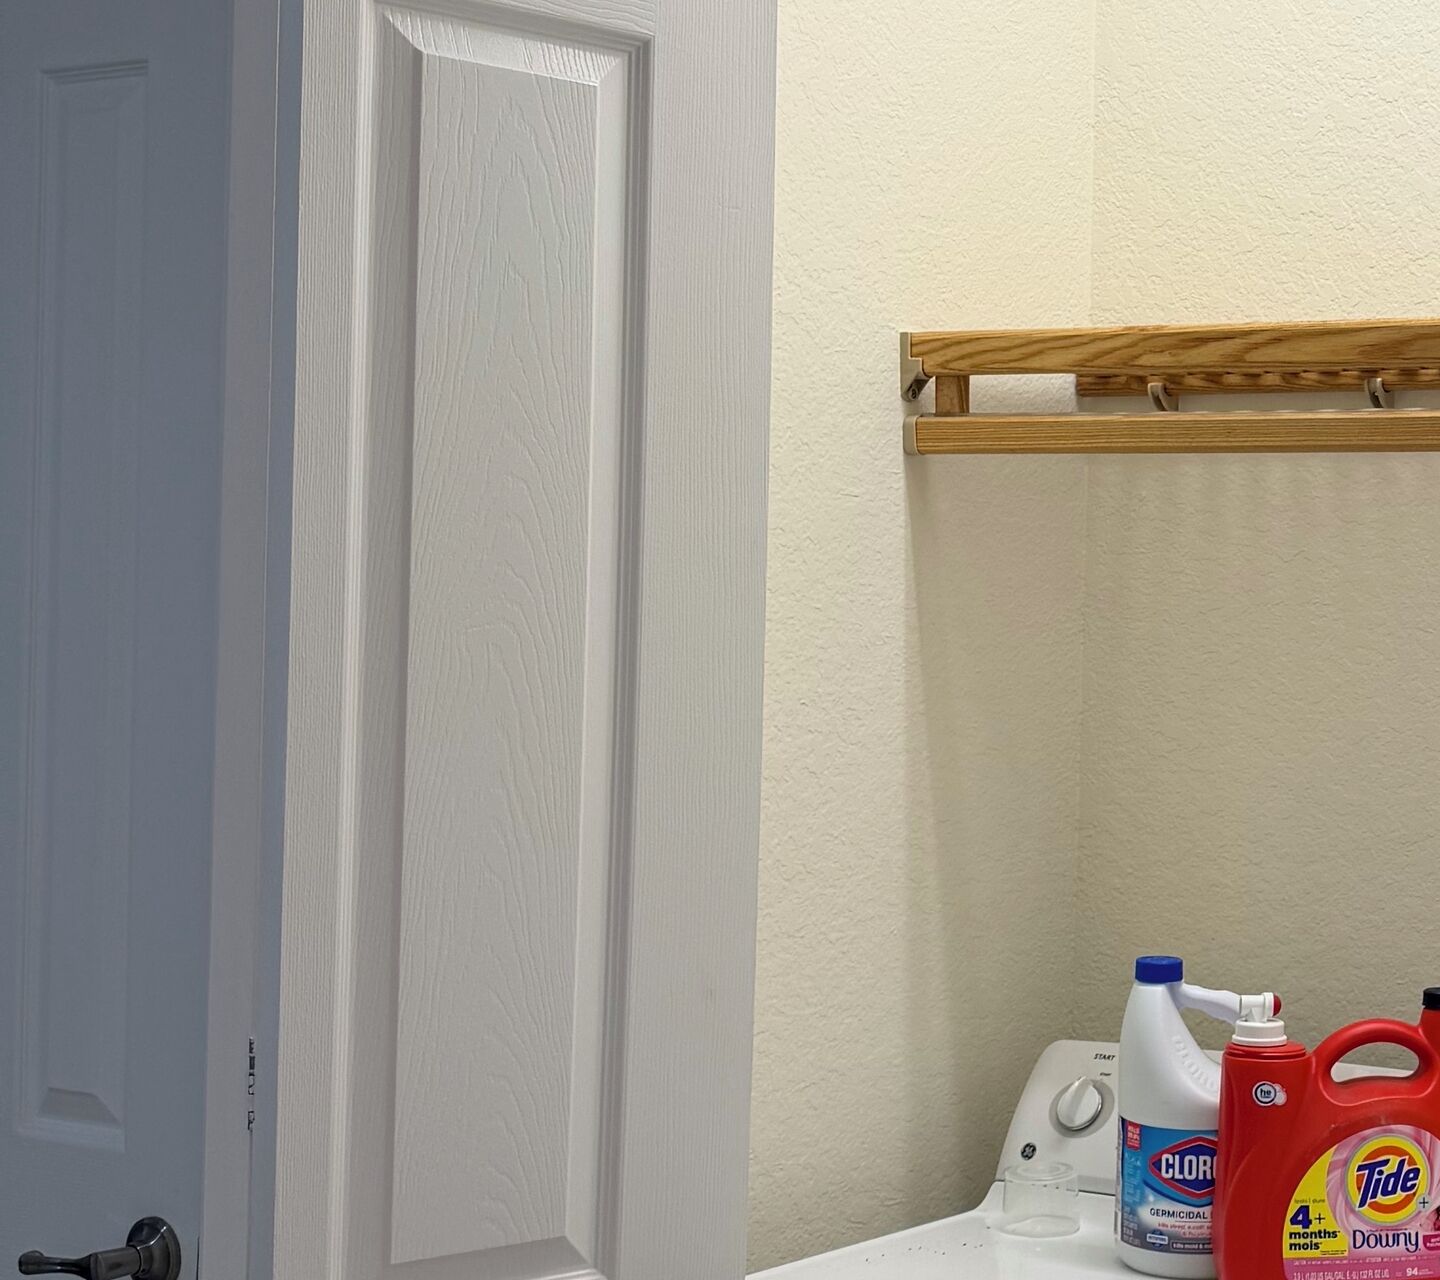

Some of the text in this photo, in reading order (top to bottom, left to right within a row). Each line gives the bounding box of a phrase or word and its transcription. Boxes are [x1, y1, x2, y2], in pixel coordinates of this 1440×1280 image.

[1094, 1053, 1116, 1061] START
[1259, 1088, 1273, 1097] he
[1356, 1157, 1421, 1208] Tide
[1149, 1207, 1208, 1220] GERMICIDAL
[1352, 1229, 1420, 1253] Downy
[1406, 1267, 1418, 1277] 94
